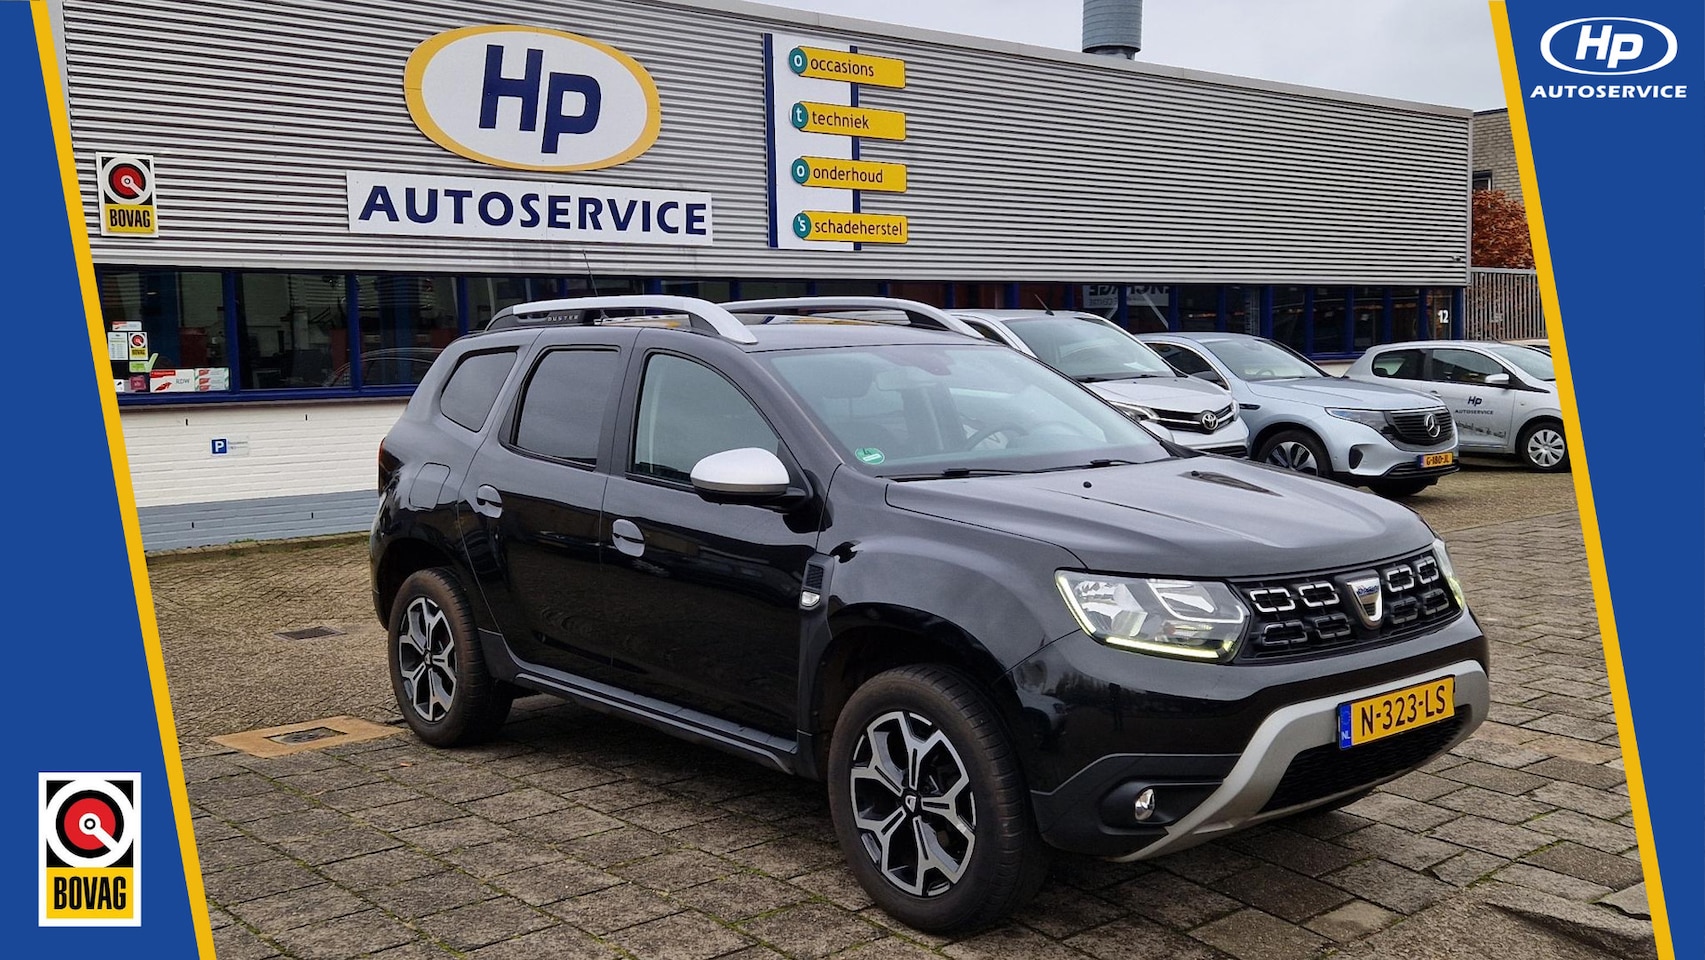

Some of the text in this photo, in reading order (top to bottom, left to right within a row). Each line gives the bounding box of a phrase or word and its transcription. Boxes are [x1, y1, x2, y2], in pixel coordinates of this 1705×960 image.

[810, 58, 875, 76] occasions
[478, 44, 601, 154] Hp
[812, 111, 870, 129] techniek
[813, 166, 883, 183] onderhoud
[110, 209, 150, 227] BOVAG
[358, 185, 707, 235] AUTOSERVICE
[815, 219, 903, 236] schadeherstel
[1437, 309, 1449, 324] 12
[1467, 396, 1482, 406] Hp
[1361, 685, 1445, 736] N-323-LS
[1341, 730, 1351, 740] NL
